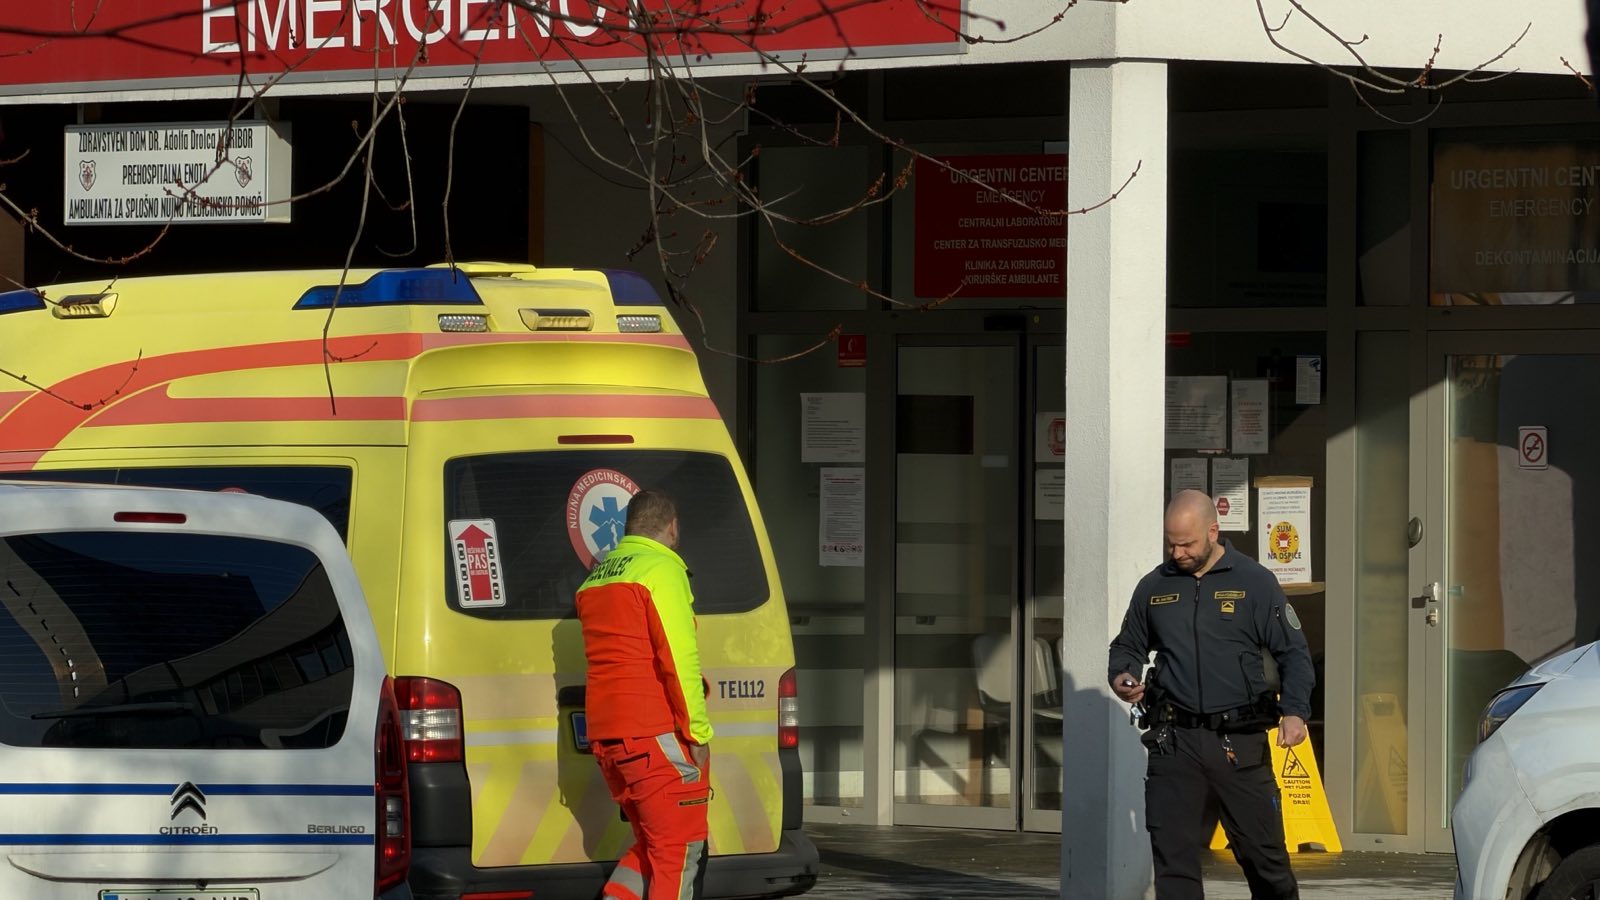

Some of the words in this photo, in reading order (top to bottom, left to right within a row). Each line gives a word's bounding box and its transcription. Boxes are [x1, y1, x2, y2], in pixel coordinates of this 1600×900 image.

[79, 131, 127, 153] ZDRAVSTVENI
[130, 130, 146, 152] DOM
[149, 130, 161, 151] DR.
[164, 129, 188, 151] Adolfa
[191, 128, 216, 150] Drolca
[123, 164, 182, 185] PREHOSPITALNA
[185, 163, 208, 184] ENOTA
[951, 167, 1015, 184] URGENTNI
[1451, 168, 1548, 189] URGENTNI
[976, 190, 1046, 203] EMERGENCY
[69, 199, 112, 220] AMBULANTA
[115, 198, 123, 219] ZA
[126, 194, 158, 218] SPLOŠNO
[161, 198, 184, 218] NUJNO
[187, 197, 232, 218] MEDICINSKO
[235, 192, 262, 217] POMOČ
[1490, 198, 1594, 216] EMERGENCY
[958, 217, 1004, 228] CENTRALNI
[934, 239, 966, 250] CENTER
[968, 239, 979, 249] ZA
[981, 238, 1047, 249] TRANSFUZIJSKO
[1049, 238, 1066, 248] MED
[965, 260, 997, 270] KLINIKA
[998, 260, 1009, 270] ZA
[1011, 259, 1056, 270] KIRURGIJO
[1009, 273, 1059, 284] AMBULANTE
[570, 494, 580, 529] NUJNA
[577, 472, 632, 493] MEDICINSKA
[468, 553, 488, 569] PAS
[159, 824, 219, 836] CITROËN
